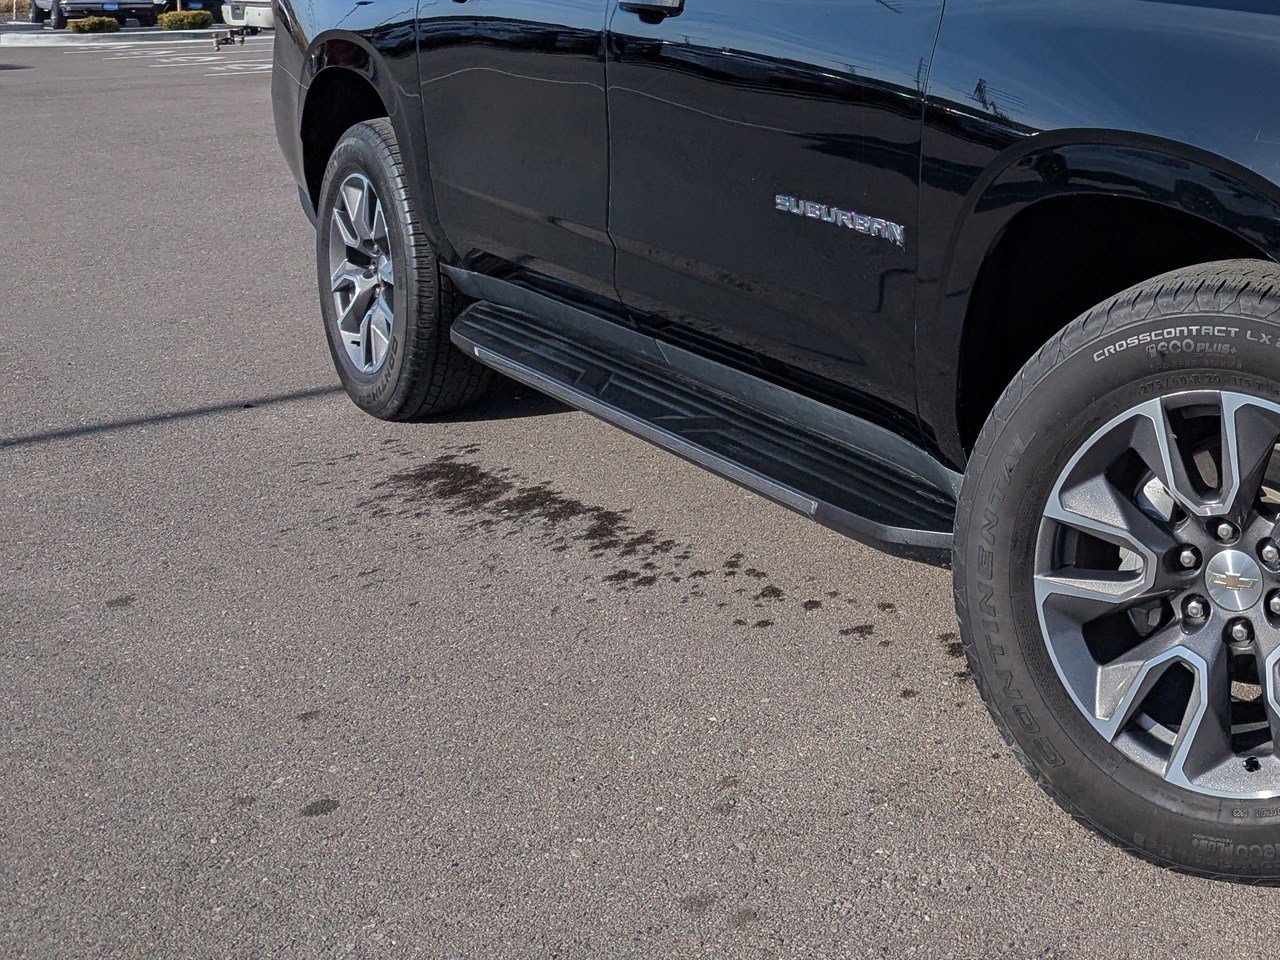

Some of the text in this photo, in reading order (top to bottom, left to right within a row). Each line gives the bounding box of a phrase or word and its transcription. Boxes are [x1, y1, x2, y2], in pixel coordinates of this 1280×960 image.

[775, 194, 905, 248] SUBURBAN
[1093, 326, 1239, 362] CROSSCONTACT
[1246, 330, 1271, 346] LX
[977, 429, 1066, 768] CONTINENTAL
